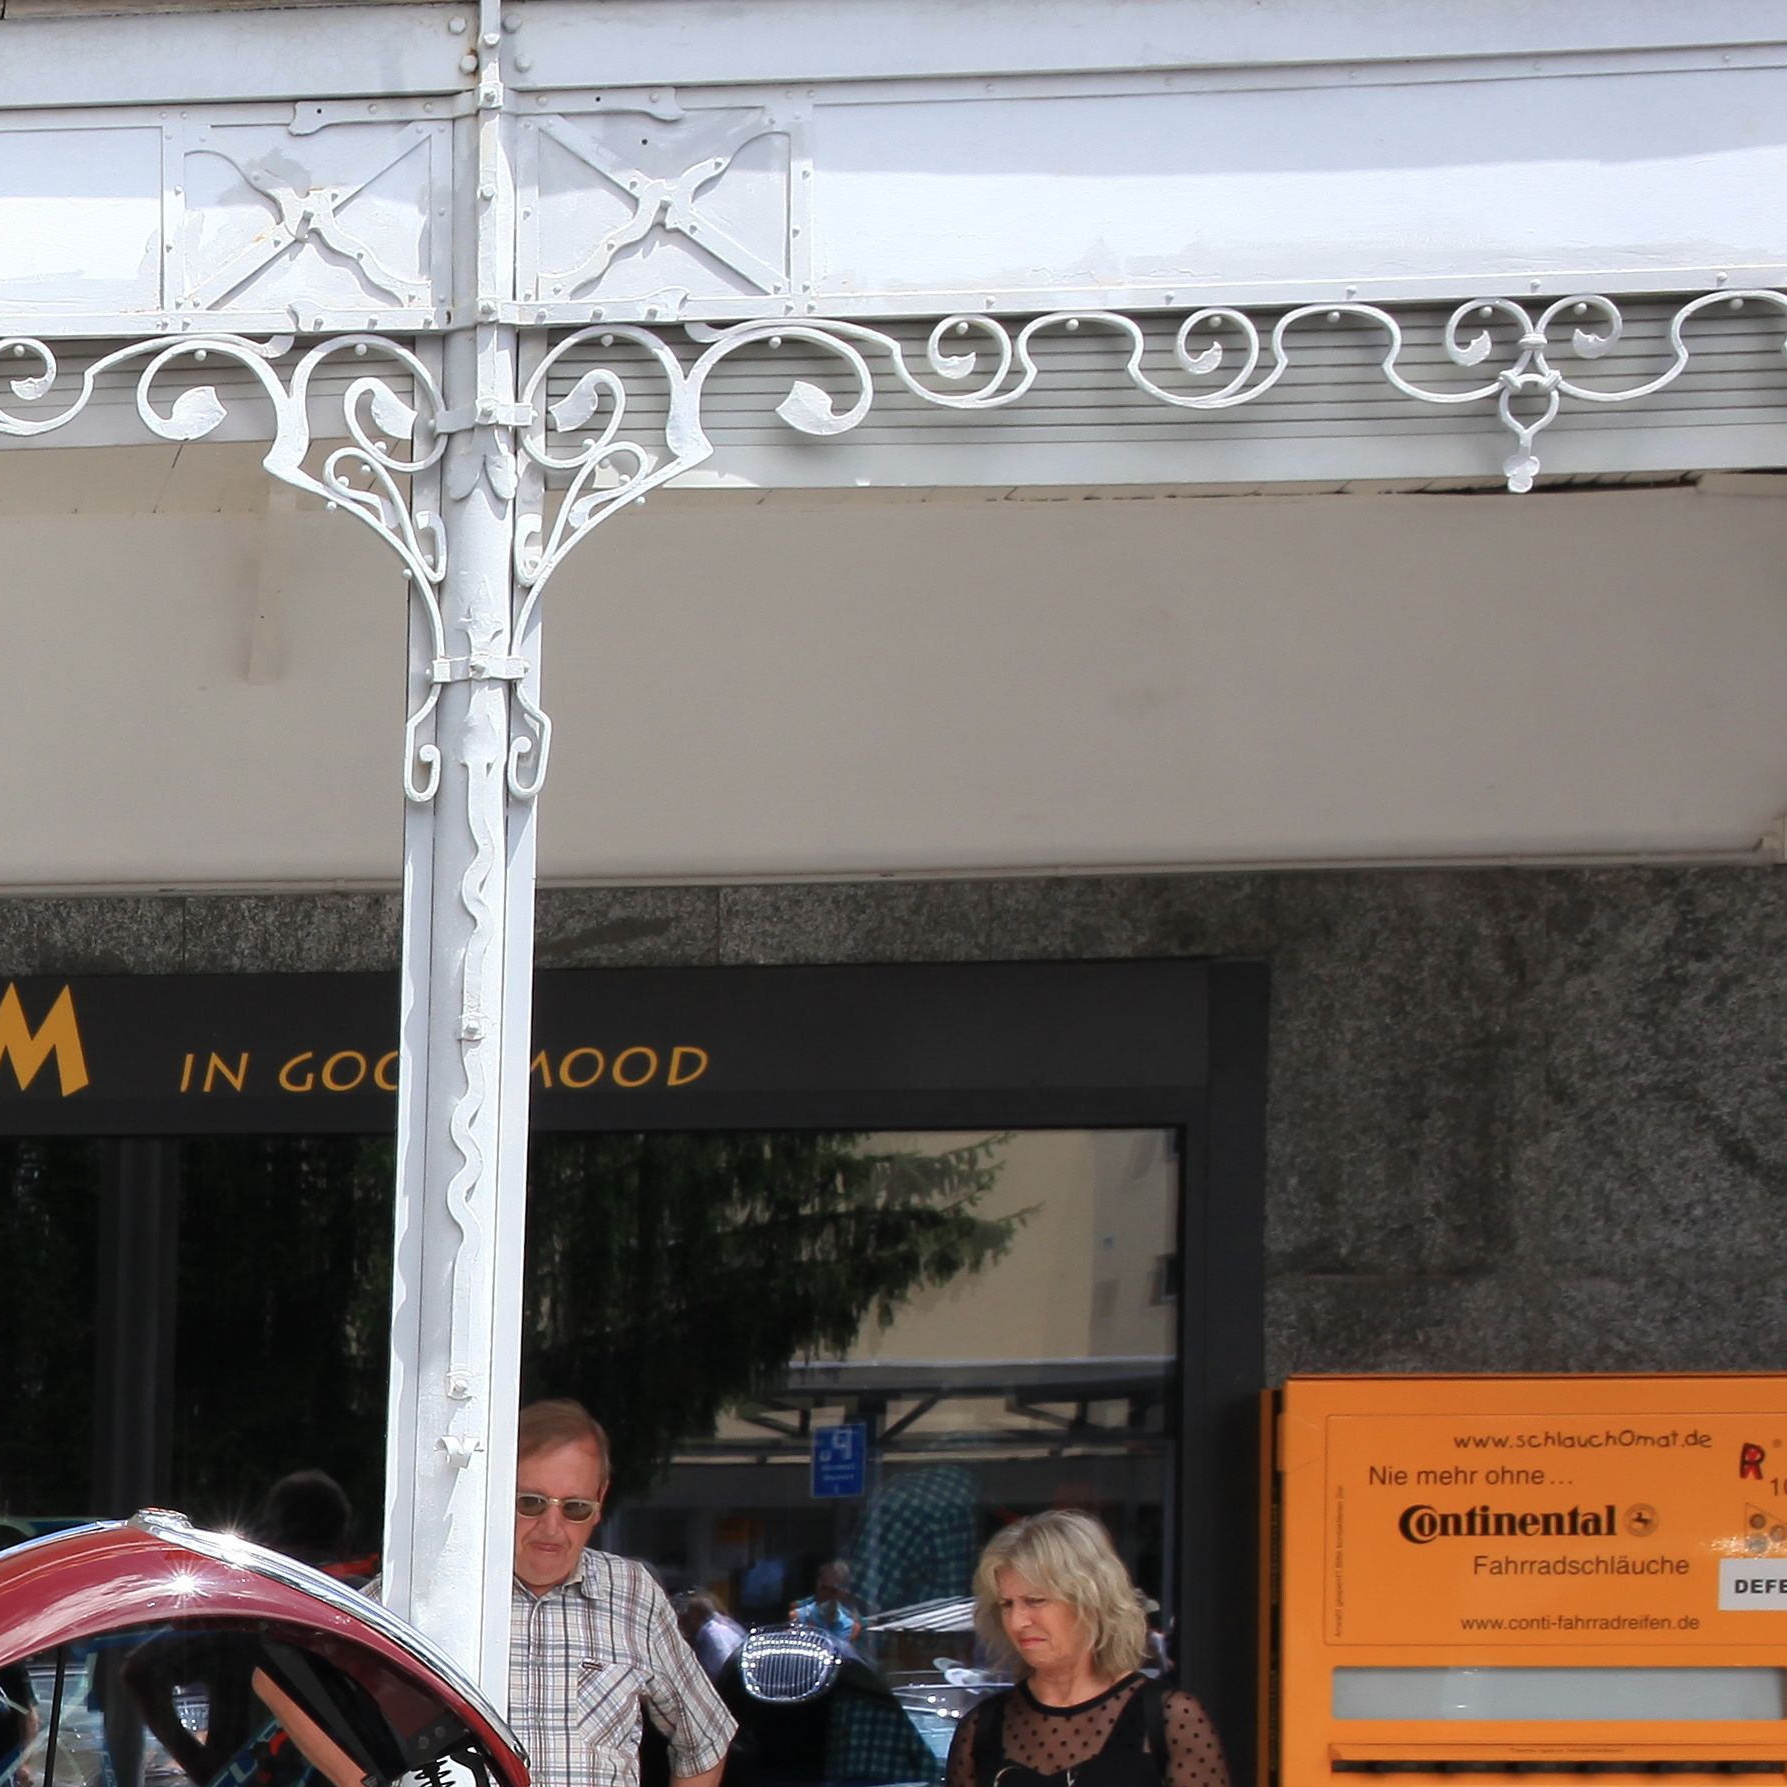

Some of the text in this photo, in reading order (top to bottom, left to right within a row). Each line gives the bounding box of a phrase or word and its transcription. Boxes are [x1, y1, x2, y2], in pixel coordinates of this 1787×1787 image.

[180, 1052, 250, 1092] IN
[278, 1051, 399, 1092] GOO
[1369, 1466, 1408, 1486] Nie
[1416, 1466, 1478, 1486] mehr
[1399, 1504, 1616, 1544] Continental
[1473, 1555, 1690, 1576] Fahrradschläuche
[1460, 1615, 1701, 1631] www.conti-fahrradreifen.de
